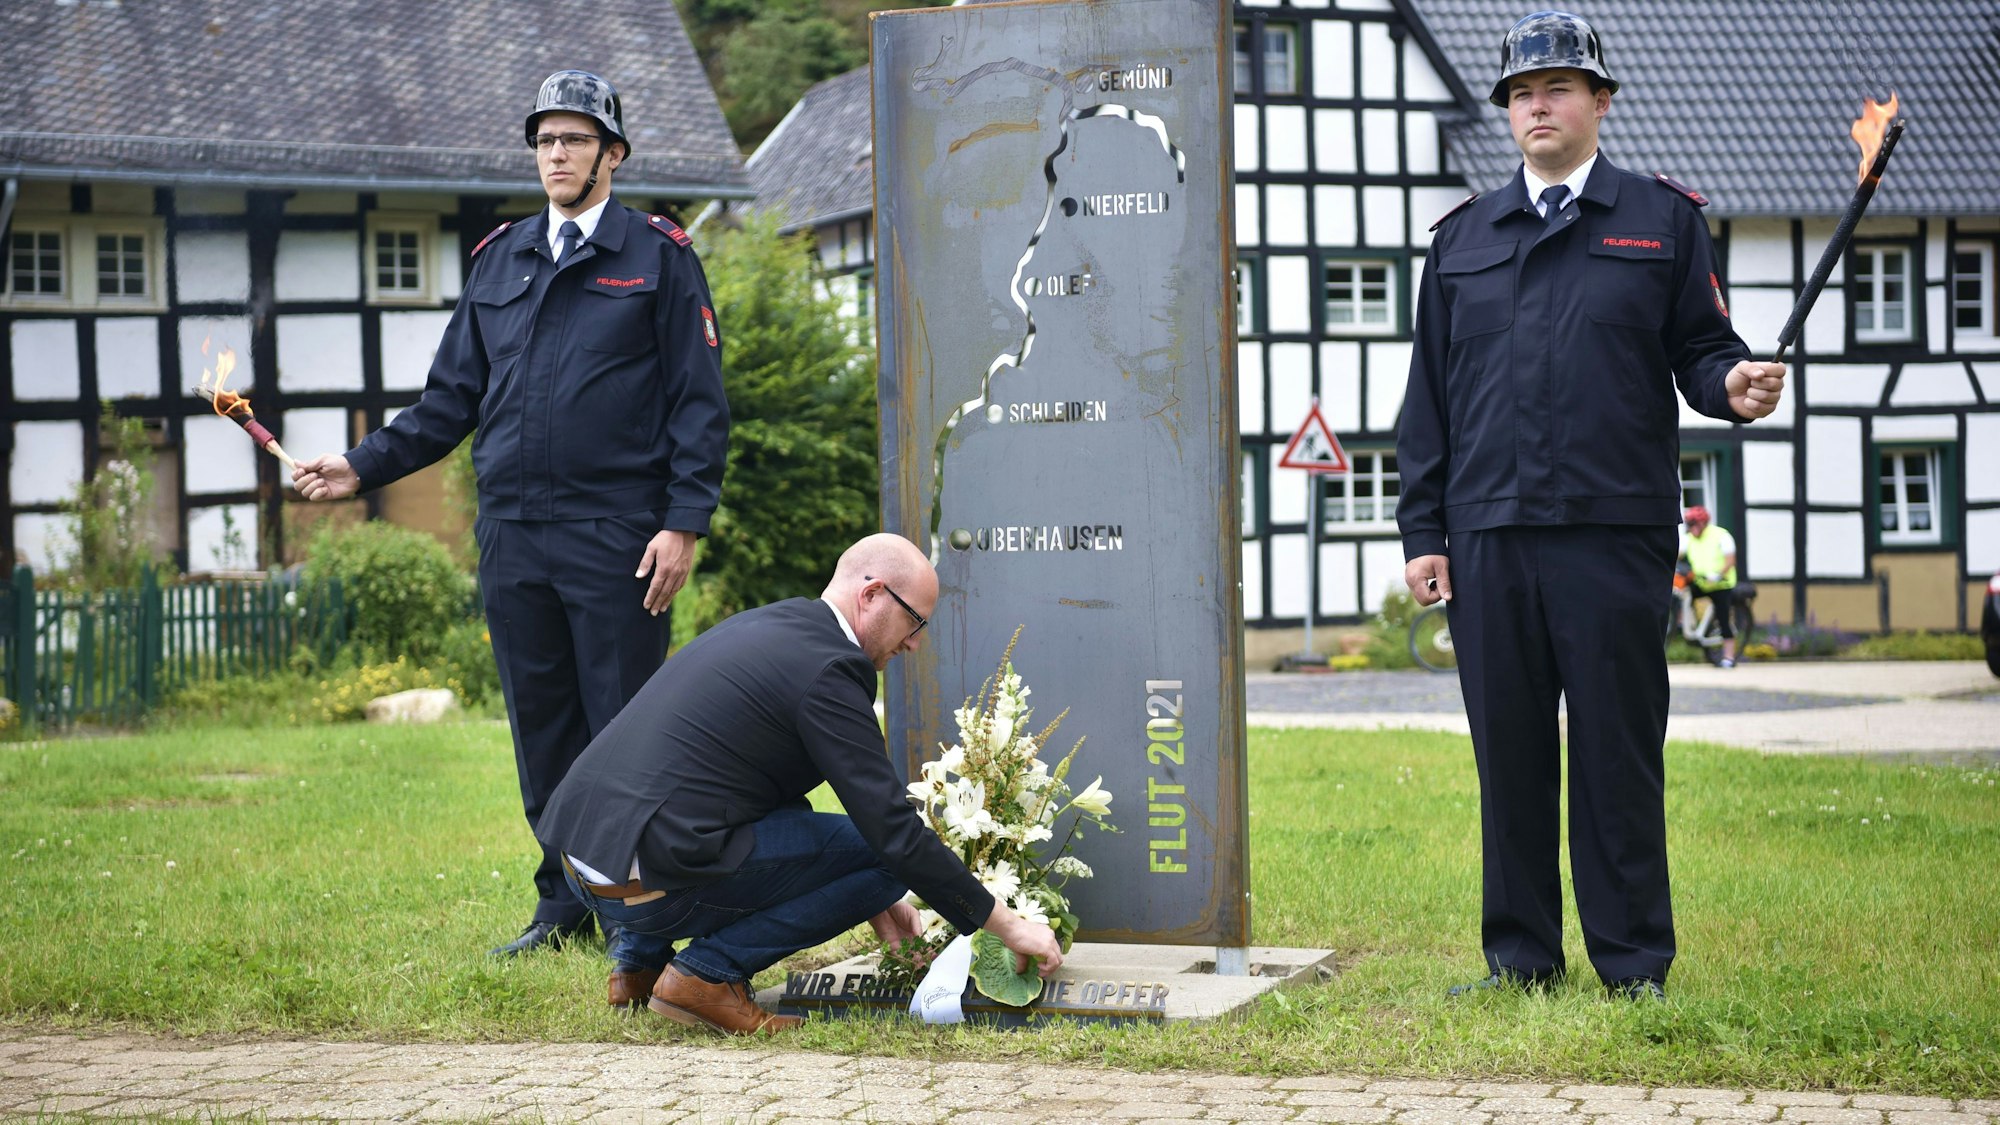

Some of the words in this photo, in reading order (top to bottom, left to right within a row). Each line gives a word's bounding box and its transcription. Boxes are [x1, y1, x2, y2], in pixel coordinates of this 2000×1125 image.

[1098, 64, 1172, 92] GEMÜND
[1083, 191, 1169, 217] NIERFELD
[1603, 238, 1661, 249] FEUERWEHR
[597, 277, 644, 287] FEUERWEHR
[1047, 273, 1092, 297] OLEF
[1009, 400, 1107, 423] SCHLEIDEN
[976, 525, 1123, 551] OBERHAUSEN
[1146, 680, 1184, 765] 2021
[1148, 777, 1187, 873] FLUT
[785, 971, 836, 996] WIR
[1080, 979, 1170, 1009] OPFER
